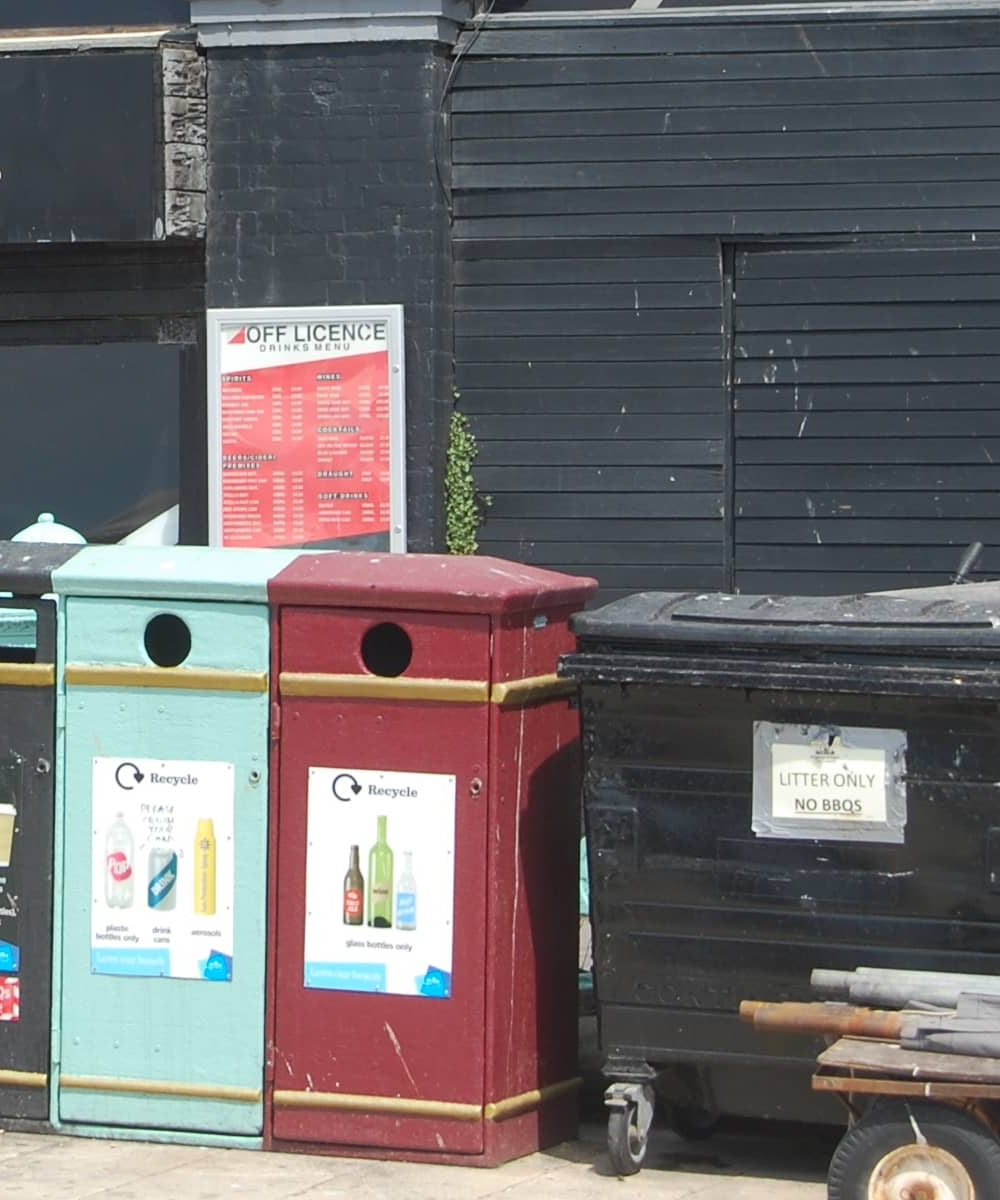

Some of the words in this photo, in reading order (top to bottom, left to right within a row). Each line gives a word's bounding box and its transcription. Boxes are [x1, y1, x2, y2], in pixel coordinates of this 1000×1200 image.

[247, 325, 287, 342] OFF
[295, 323, 386, 341] LICENCE
[259, 344, 309, 352] DRINKS
[315, 343, 350, 351] MENU
[150, 772, 198, 787] Recycle
[779, 772, 829, 787] LITTER
[834, 773, 876, 788] ONLY
[368, 784, 418, 799] Recycle
[795, 798, 817, 811] NO
[822, 799, 862, 814] BBQS
